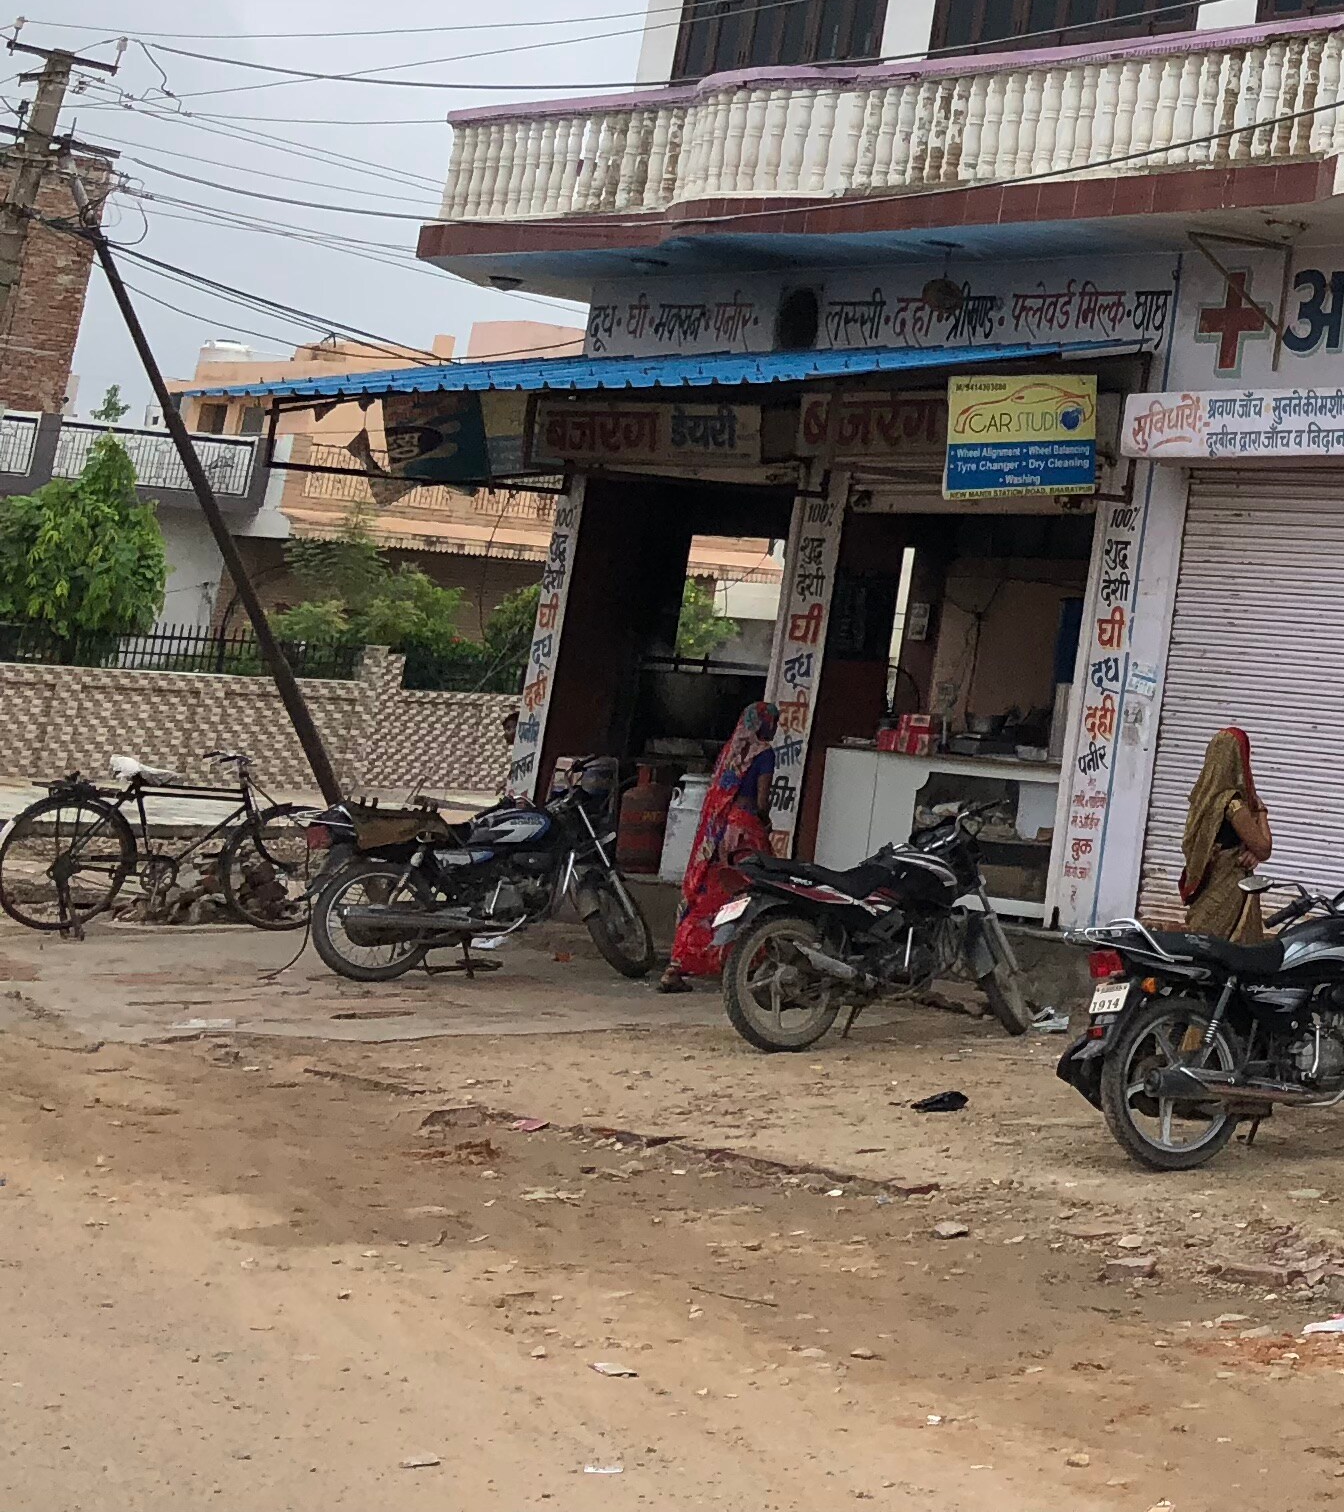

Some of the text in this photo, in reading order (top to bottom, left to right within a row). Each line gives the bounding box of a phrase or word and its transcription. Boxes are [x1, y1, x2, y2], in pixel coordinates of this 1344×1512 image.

[590, 304, 618, 353] दूध
[627, 292, 650, 339] घी
[1134, 290, 1172, 351] छाछ
[968, 412, 1012, 434] CAR
[956, 444, 1090, 460] Wheel Alignment Wheel Balancing
[956, 457, 1090, 473] Tyre Changer Dry Cleaning
[950, 490, 967, 499] NEW
[993, 489, 1024, 497] STATION
[1004, 473, 1041, 484] Washing
[807, 501, 838, 528] 100%
[1109, 506, 1142, 533] 100%
[1104, 538, 1132, 571] शुद्ध
[796, 564, 826, 603] देशी
[1100, 572, 1131, 608] देशी
[539, 592, 560, 630] घी
[788, 602, 823, 645] घी
[1096, 605, 1127, 651] घी
[1091, 656, 1121, 696] दूध
[778, 689, 810, 734] दही
[1084, 693, 1117, 743] दही
[1078, 744, 1109, 776] पनीर
[1071, 837, 1094, 862] बुक
